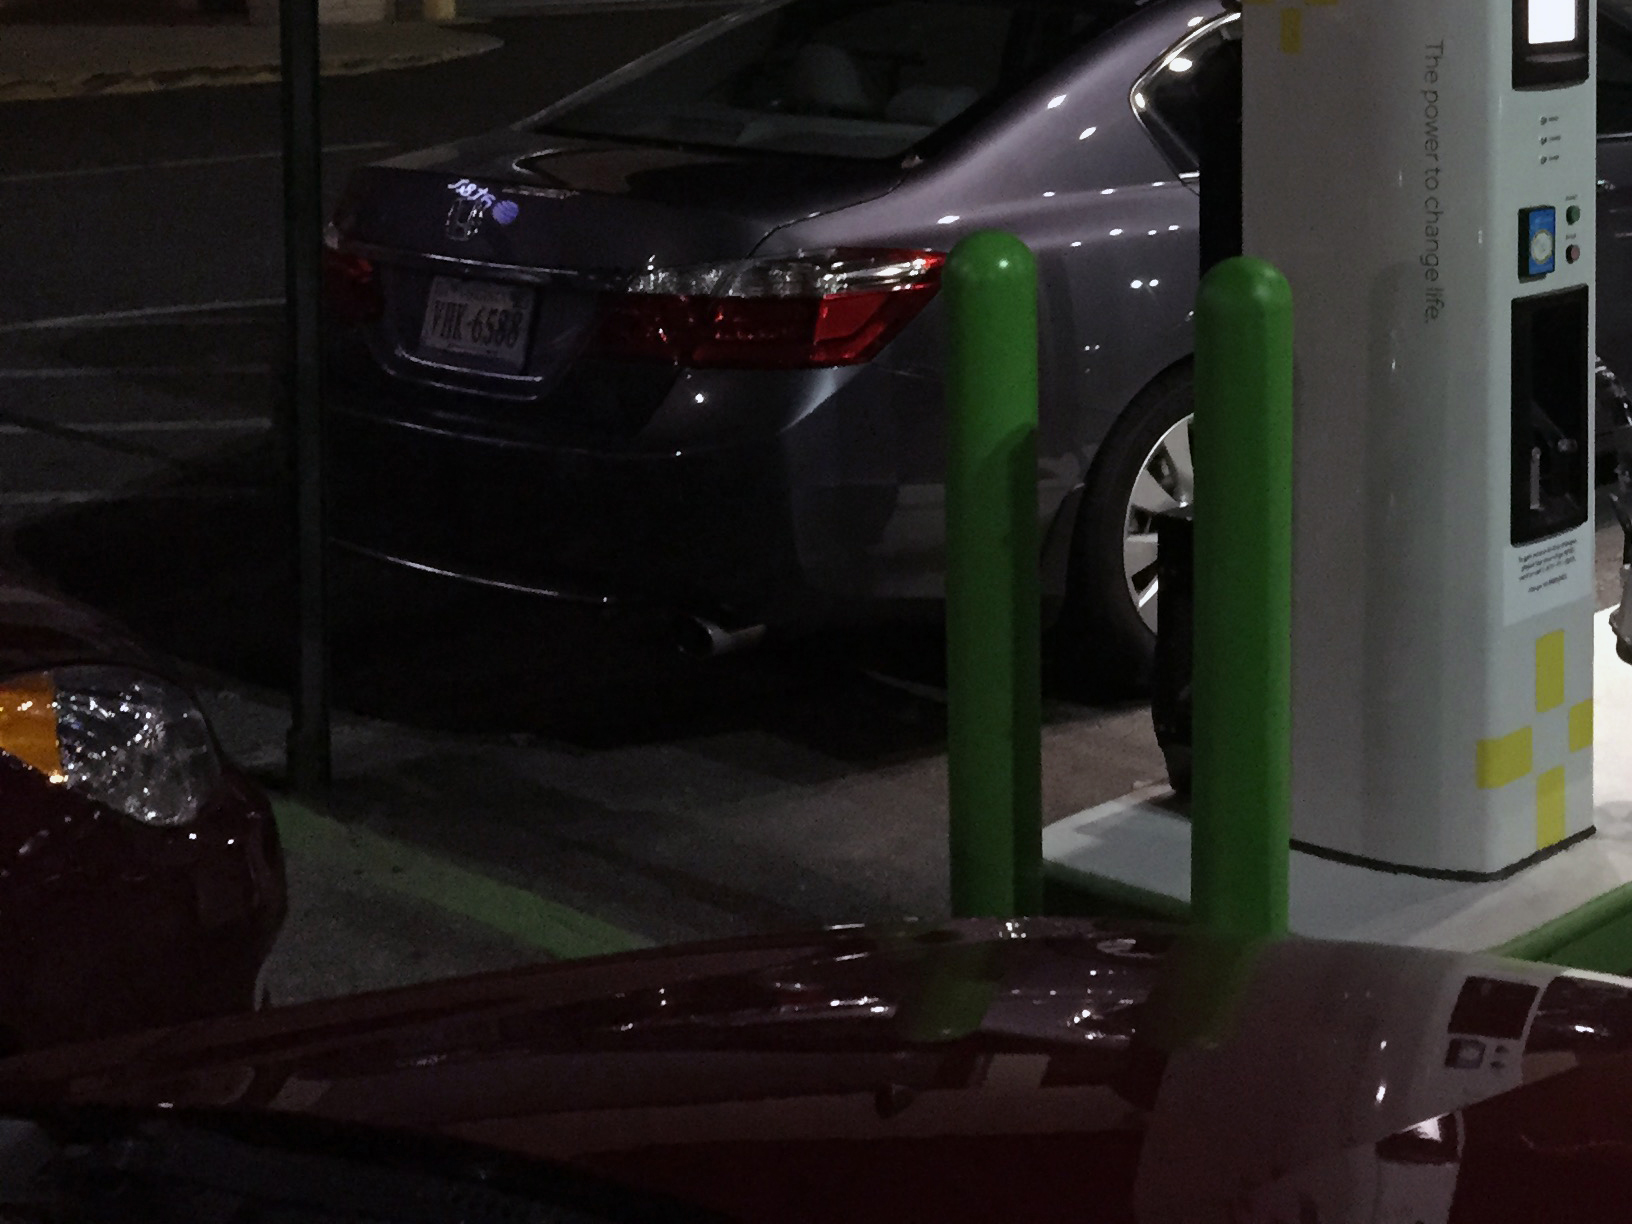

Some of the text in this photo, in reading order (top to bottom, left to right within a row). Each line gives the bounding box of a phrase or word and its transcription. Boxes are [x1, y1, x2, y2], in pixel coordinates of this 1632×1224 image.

[1424, 39, 1444, 84] The
[1420, 89, 1440, 162] power
[1424, 167, 1441, 191] to
[1419, 196, 1444, 282] change
